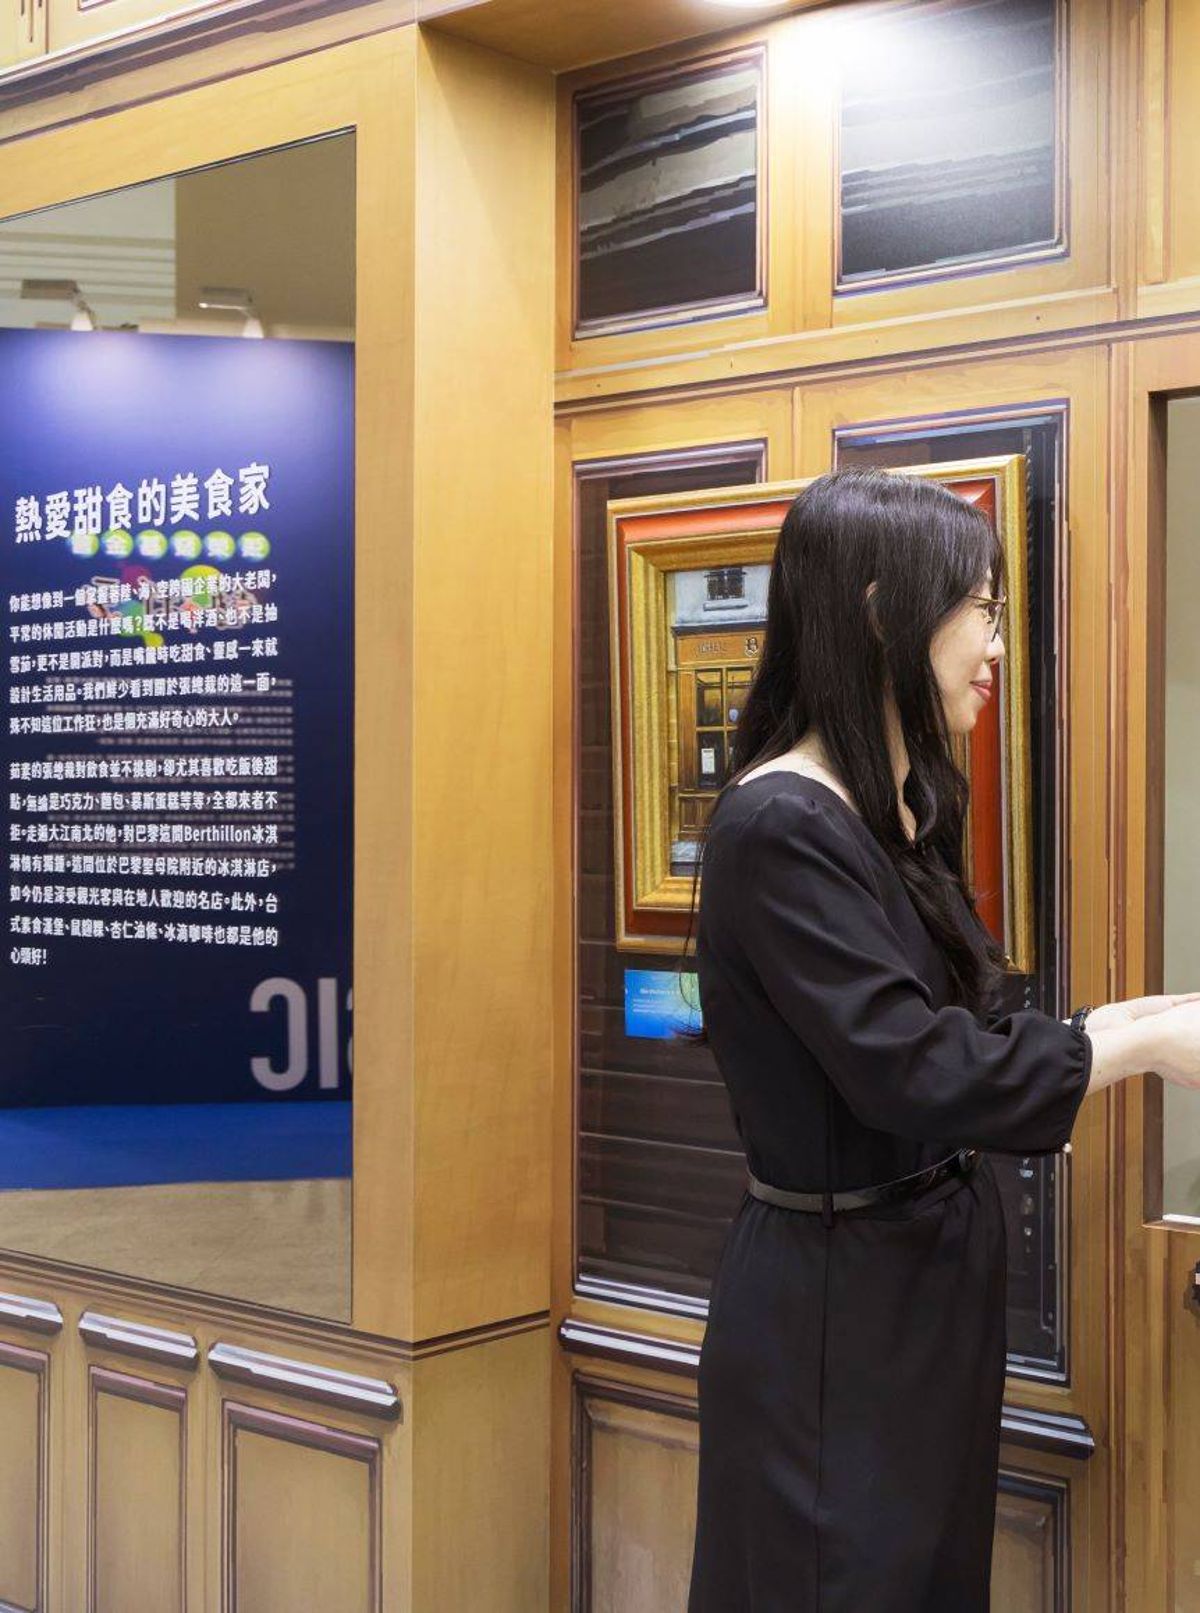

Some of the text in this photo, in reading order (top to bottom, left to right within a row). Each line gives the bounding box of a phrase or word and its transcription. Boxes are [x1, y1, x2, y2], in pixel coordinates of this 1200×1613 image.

[14, 461, 271, 544] 熱愛甜食的美食家
